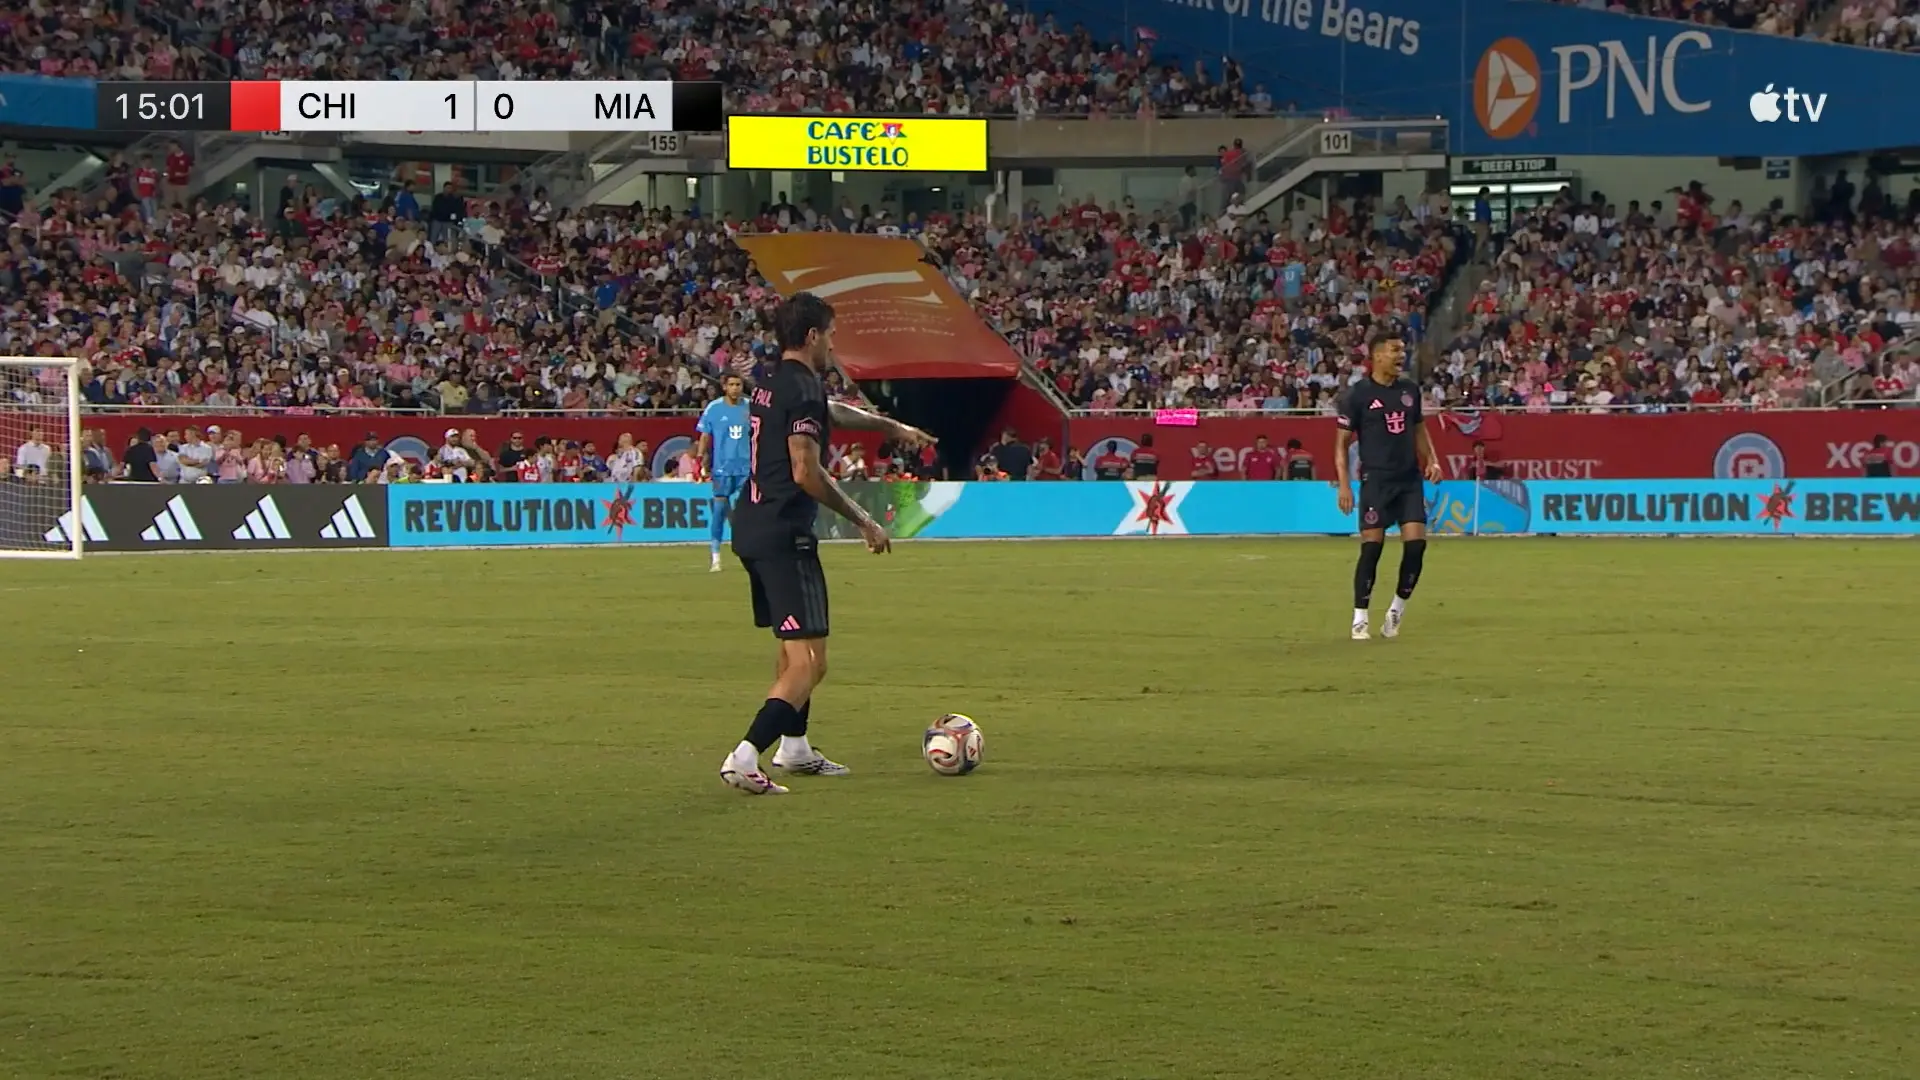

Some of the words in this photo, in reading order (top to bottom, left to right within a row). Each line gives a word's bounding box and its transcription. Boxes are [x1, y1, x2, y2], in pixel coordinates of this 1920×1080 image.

[1261, 0, 1312, 30] the
[1321, 0, 1420, 55] Bears
[1551, 30, 1712, 124] PNC
[650, 135, 678, 151] 155
[1324, 133, 1349, 150] 101
[807, 145, 909, 167] BUSTELO
[1481, 160, 1513, 173] BEER
[1515, 159, 1547, 171] STOP
[1446, 454, 1599, 480] WTRUST
[1826, 441, 1919, 469] xeo
[404, 498, 596, 533] REVOLUTION
[1542, 493, 1750, 522] REVOLUTION
